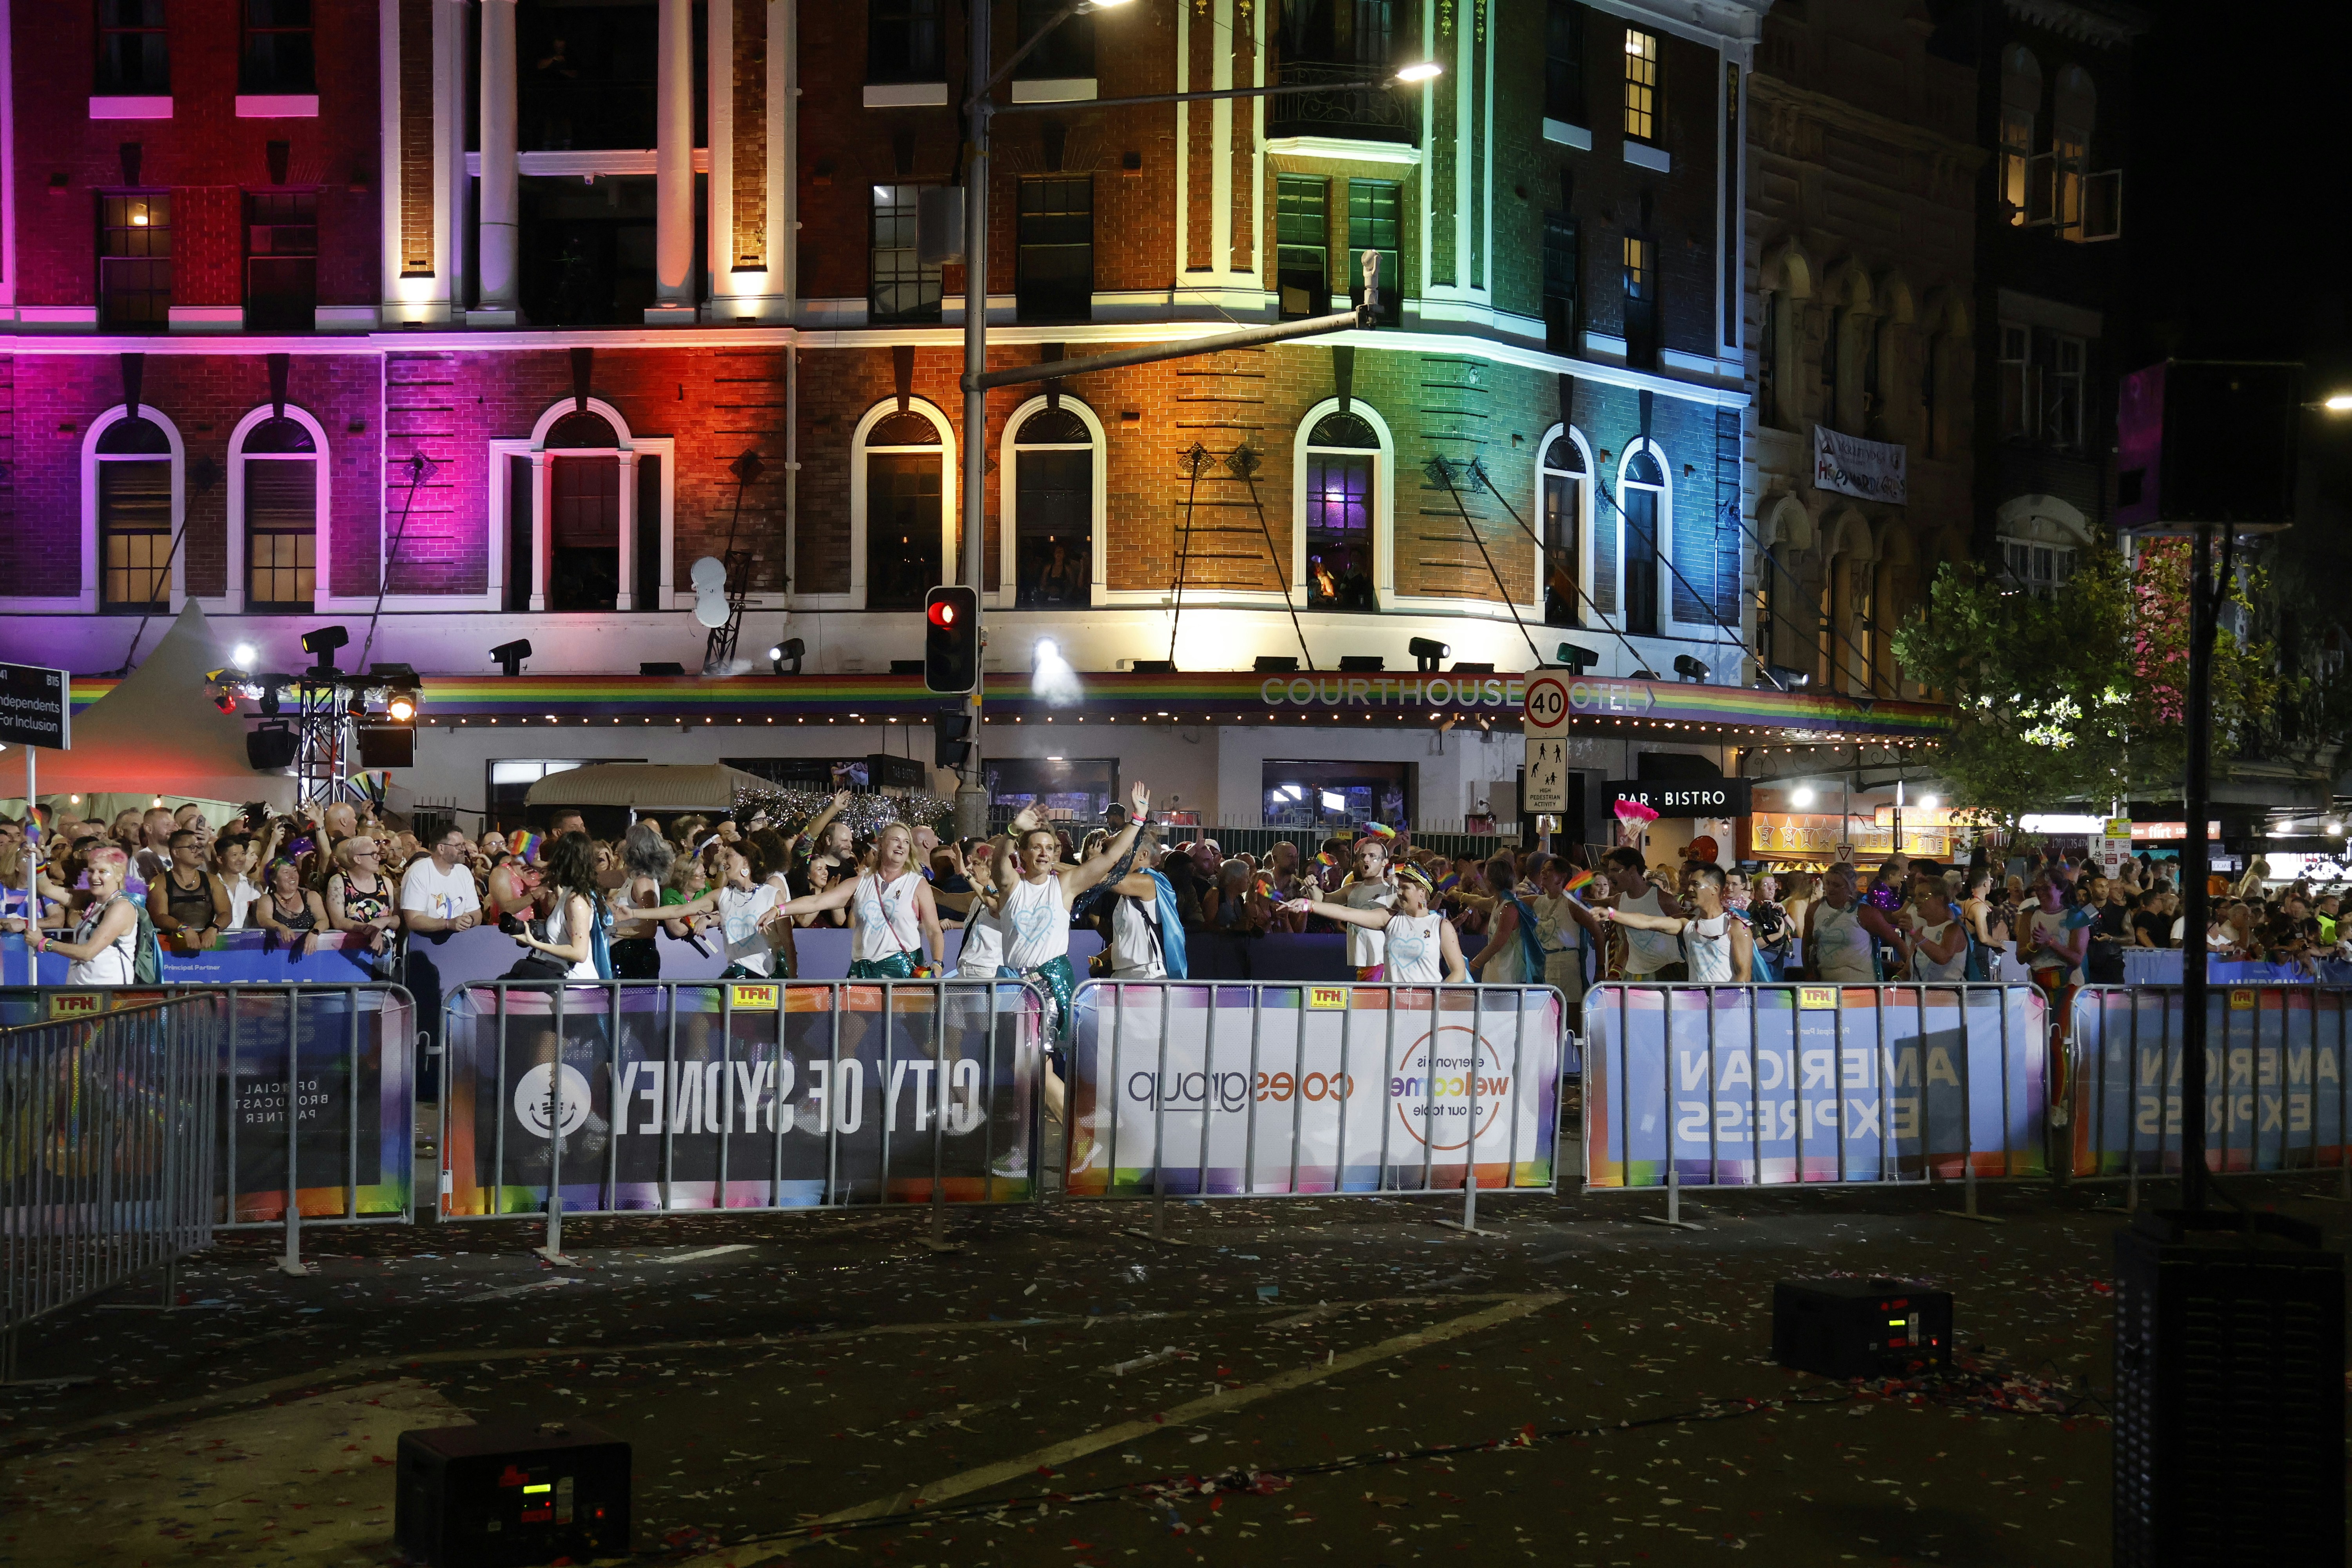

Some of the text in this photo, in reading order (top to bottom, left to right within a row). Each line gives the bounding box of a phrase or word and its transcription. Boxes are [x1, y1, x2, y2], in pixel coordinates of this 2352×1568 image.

[46, 675, 60, 687] B15
[1261, 678, 1637, 711] COURTHOUSE OTEL
[0, 693, 60, 713] ndependents
[1532, 692, 1561, 713] 40
[16, 715, 58, 733] Inclusion
[1665, 791, 1725, 806] BISTRO
[1904, 815, 1933, 823] TAR
[1762, 826, 1769, 841] 5
[1784, 826, 1844, 843] STAR
[1858, 826, 1911, 848] KEBB
[2148, 824, 2172, 838] flirt
[1917, 837, 1943, 853] PIDE
[738, 987, 769, 1000] TFH
[1315, 990, 1340, 1002] TFH
[1805, 990, 1829, 1001] TFH
[56, 997, 93, 1010] TFH
